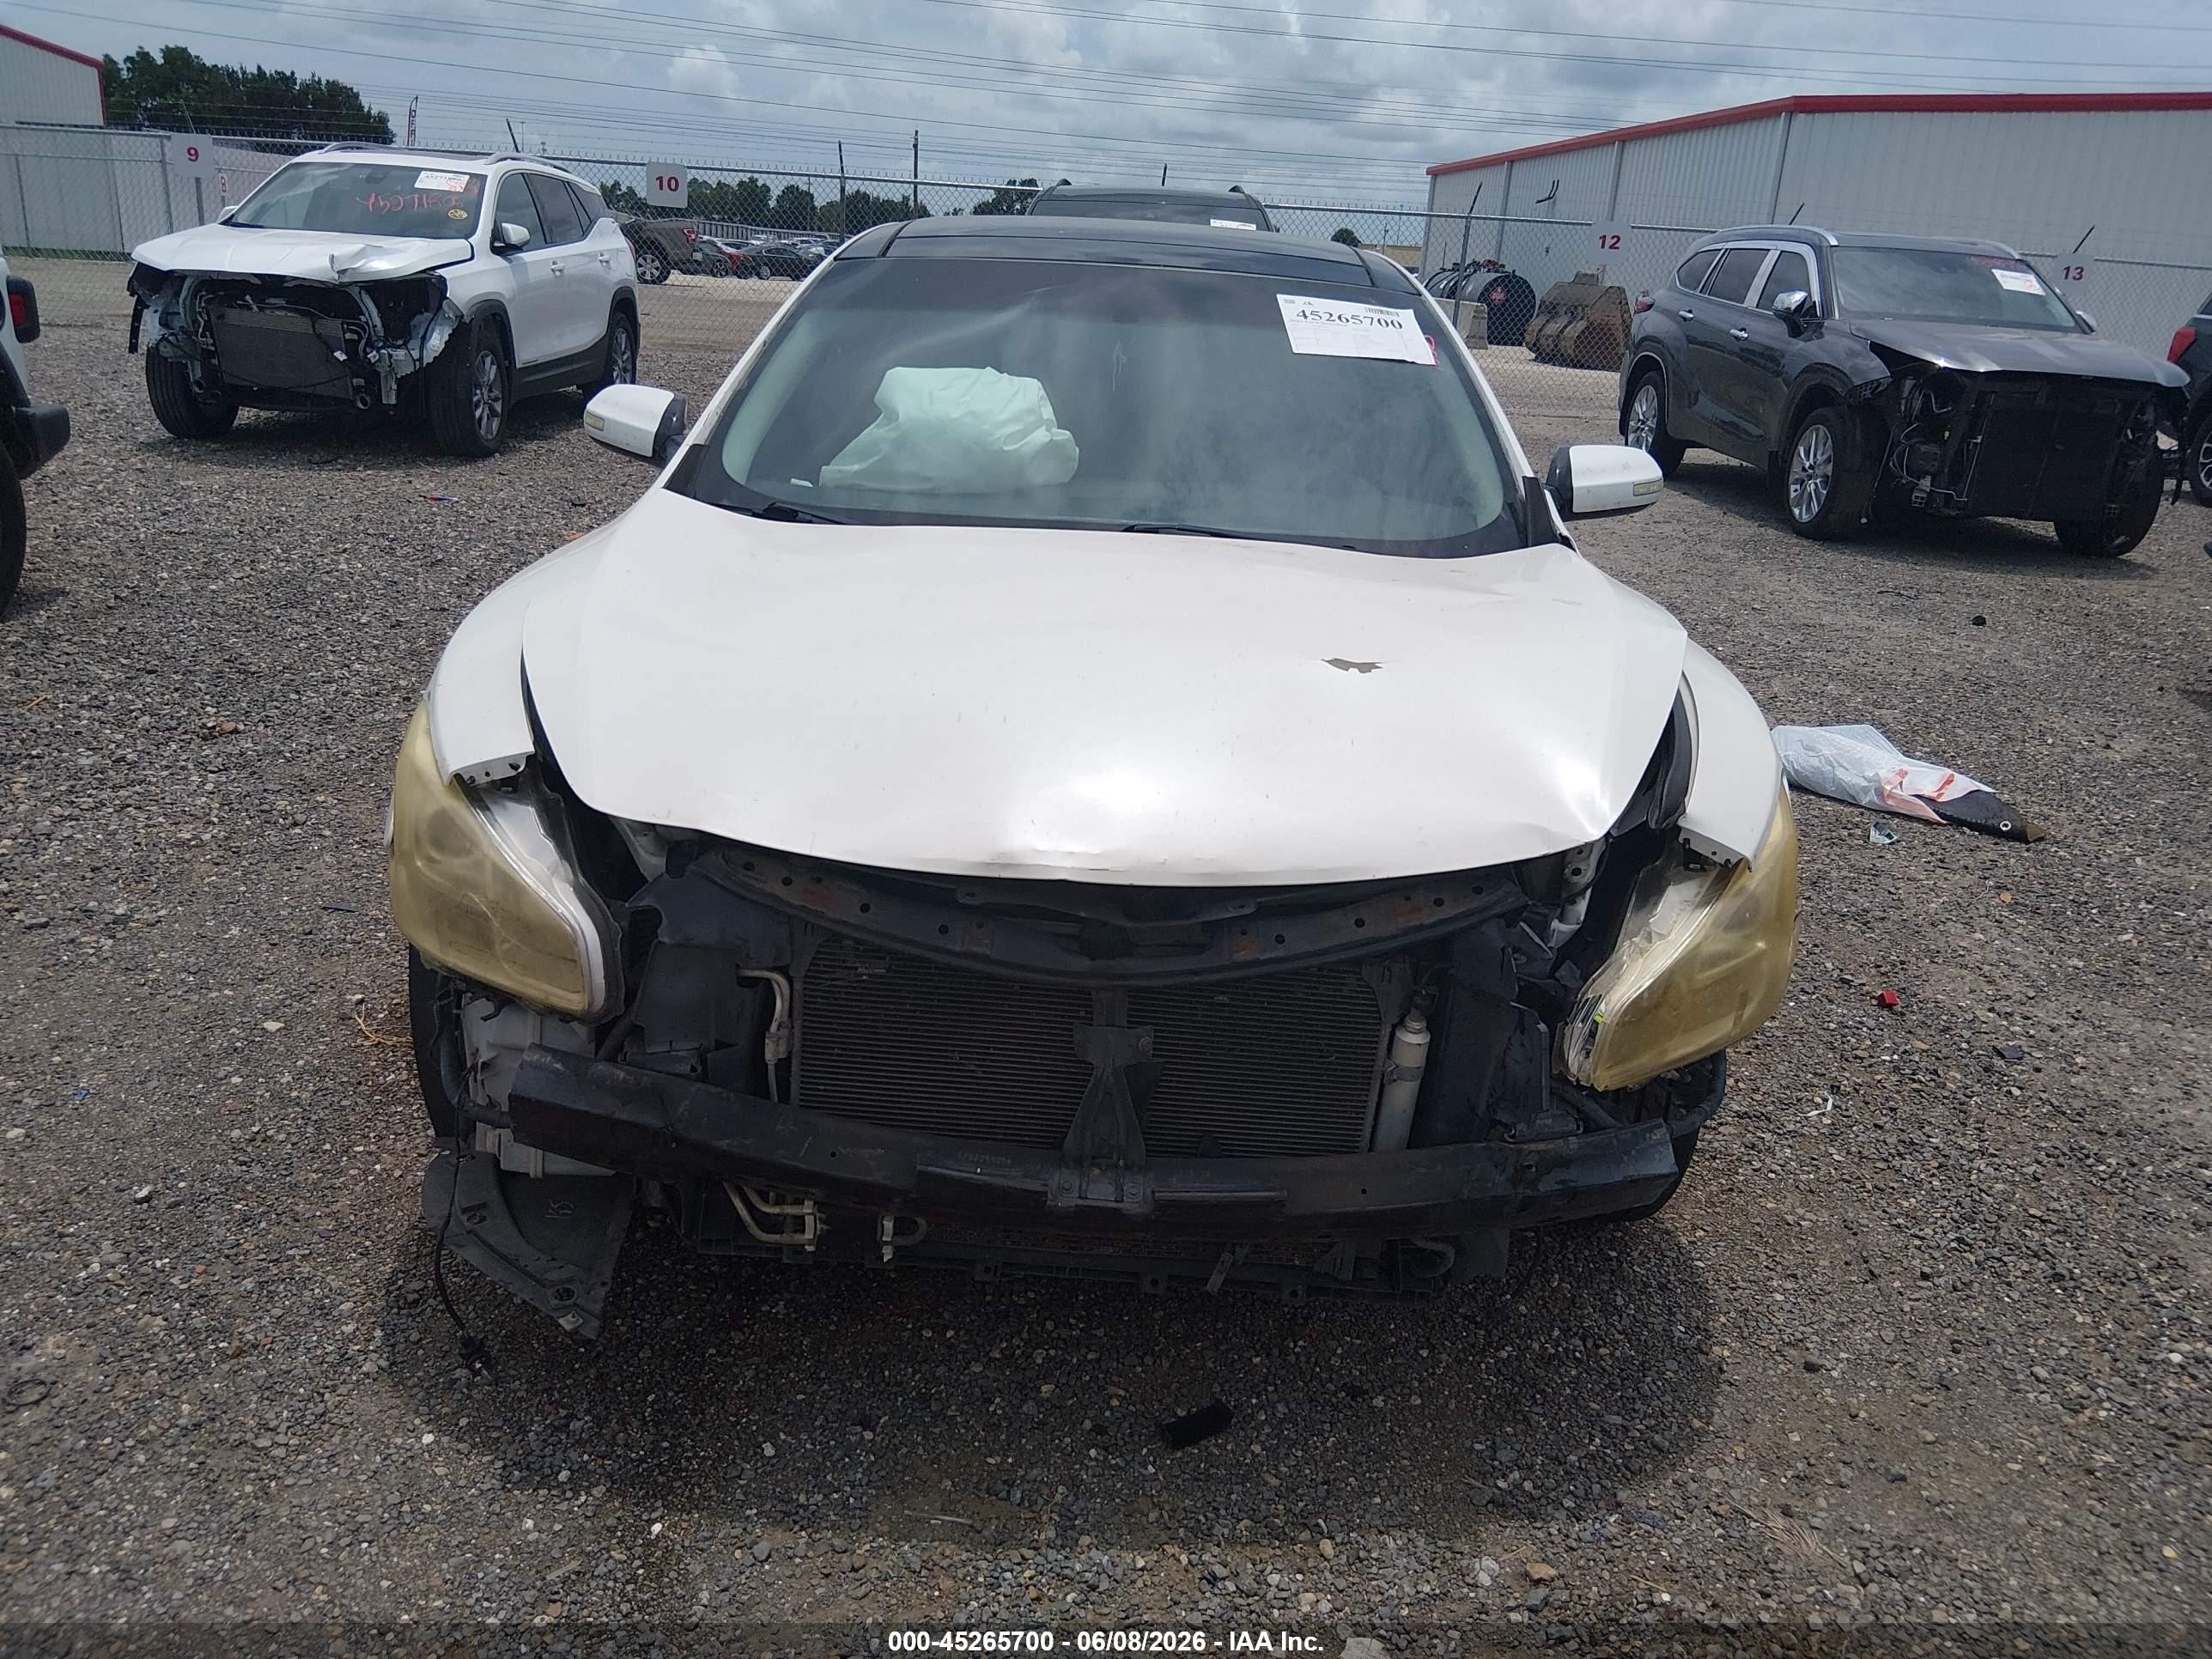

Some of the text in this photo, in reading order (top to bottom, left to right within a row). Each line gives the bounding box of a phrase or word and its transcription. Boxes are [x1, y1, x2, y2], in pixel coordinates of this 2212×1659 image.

[186, 146, 199, 162] 9
[655, 175, 679, 192] 10
[1598, 234, 1621, 250] 12
[2063, 265, 2085, 281] 13
[1296, 309, 1403, 331] 45265700
